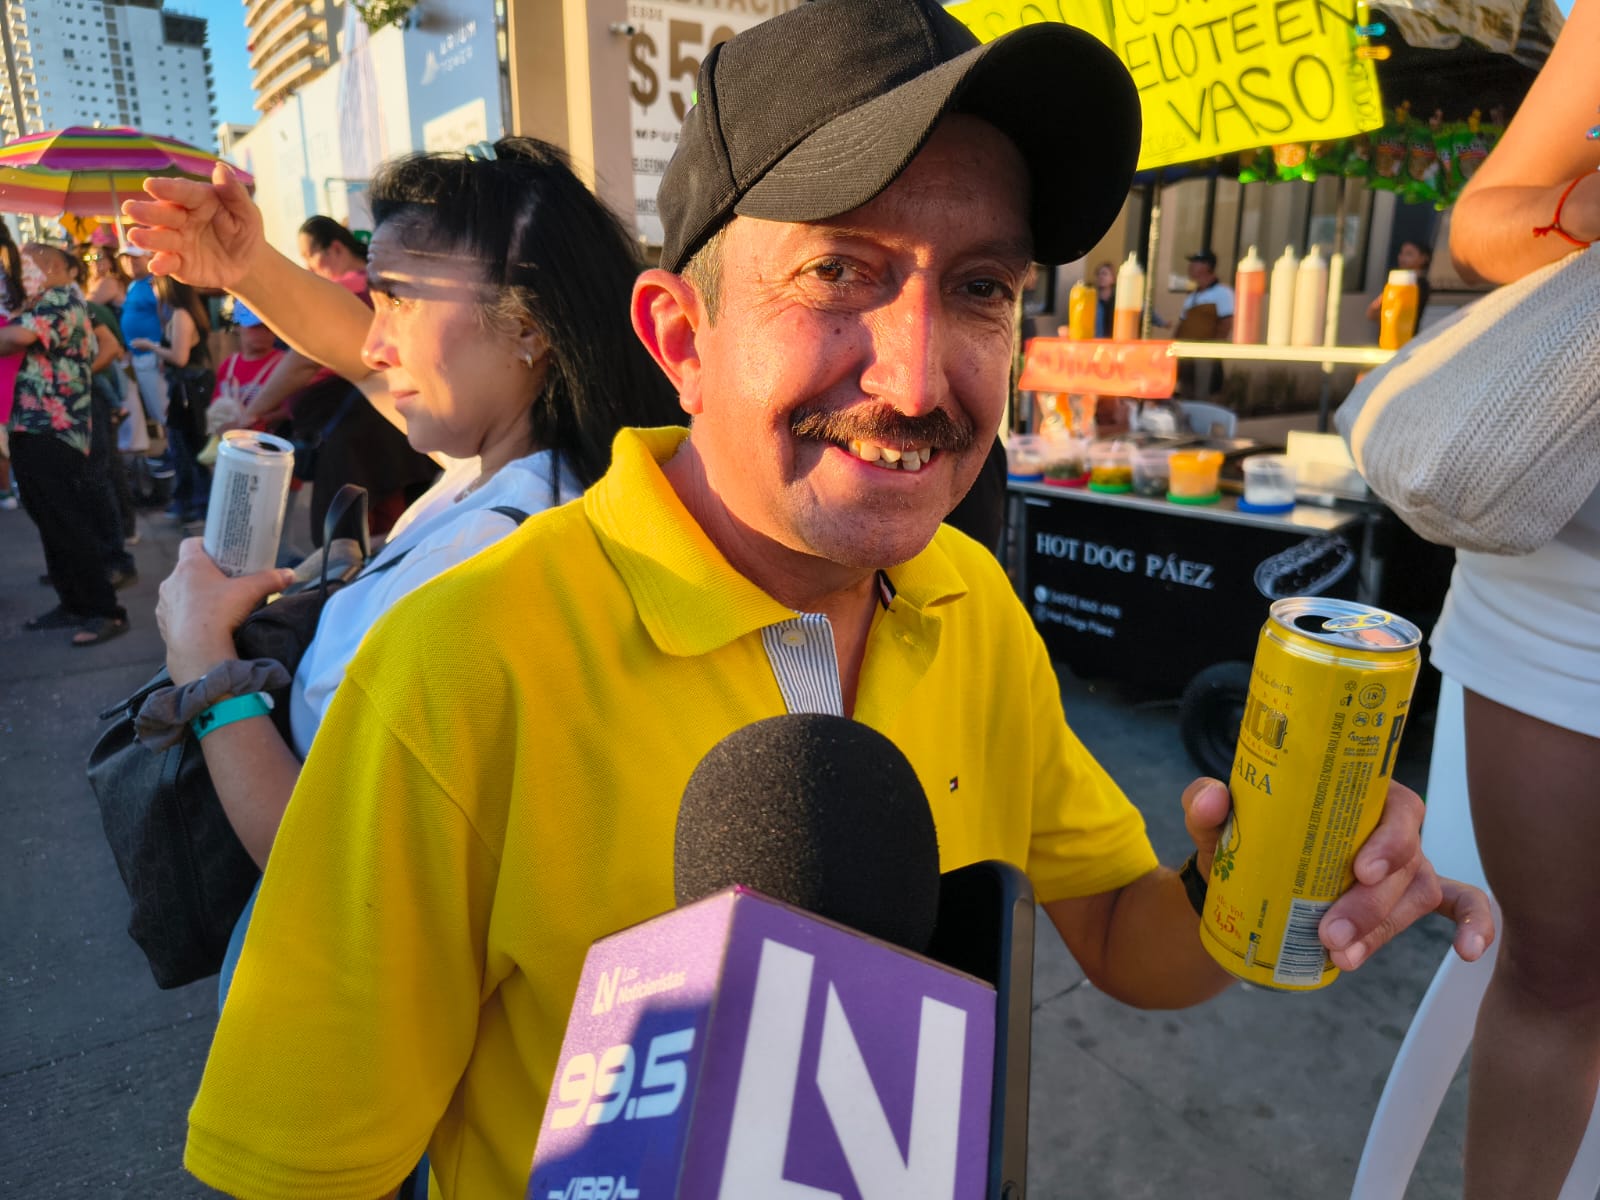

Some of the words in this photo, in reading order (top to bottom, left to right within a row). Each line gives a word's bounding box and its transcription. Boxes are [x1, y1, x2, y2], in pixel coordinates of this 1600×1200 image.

[629, 19, 737, 124] $5
[1166, 55, 1335, 144] VASO
[1037, 532, 1080, 560] HOT
[1084, 542, 1136, 573] DOG
[1146, 553, 1215, 589] PÁEZ
[550, 1027, 697, 1130] 99.5
